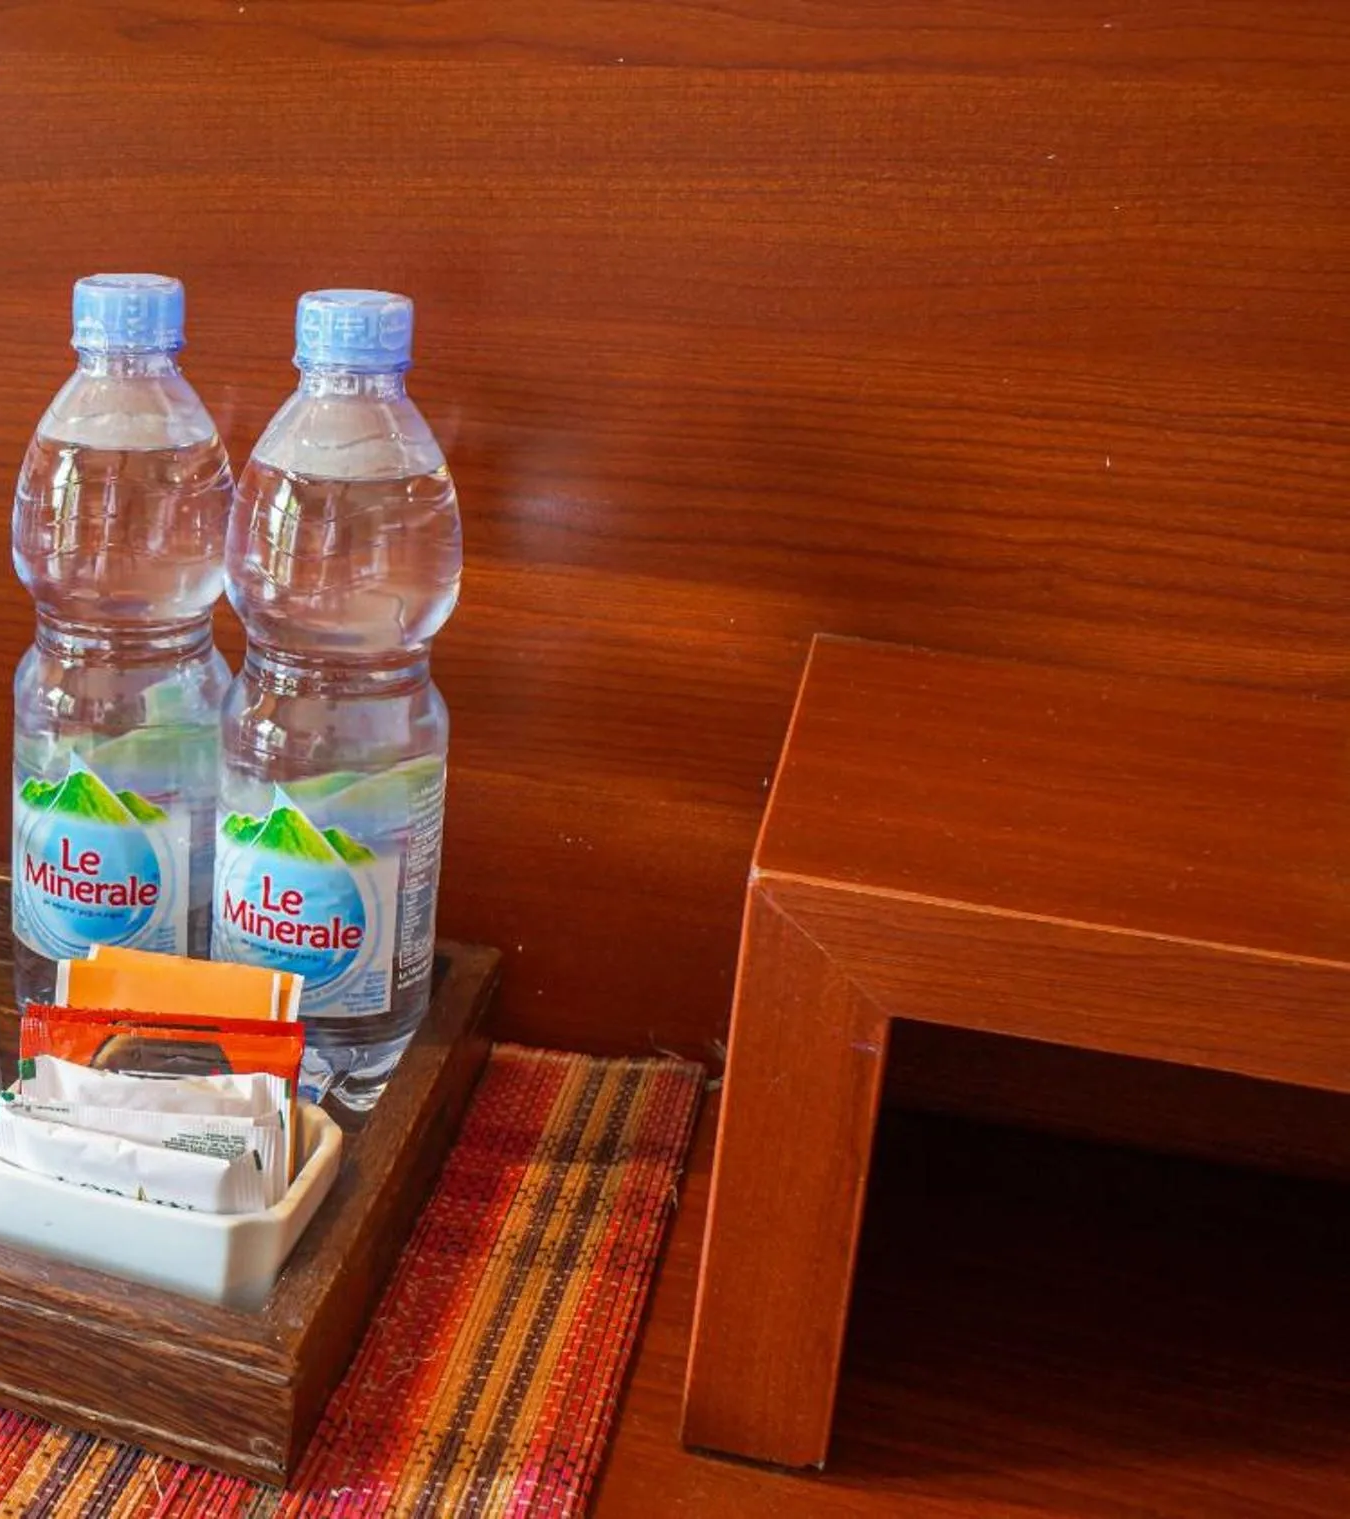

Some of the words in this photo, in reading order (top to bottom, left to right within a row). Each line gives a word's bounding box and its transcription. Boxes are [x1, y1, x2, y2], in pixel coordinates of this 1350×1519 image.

[25, 853, 158, 907] Minerale
[61, 837, 100, 876] Le
[262, 875, 303, 915] Le
[223, 889, 363, 950] Minerale
